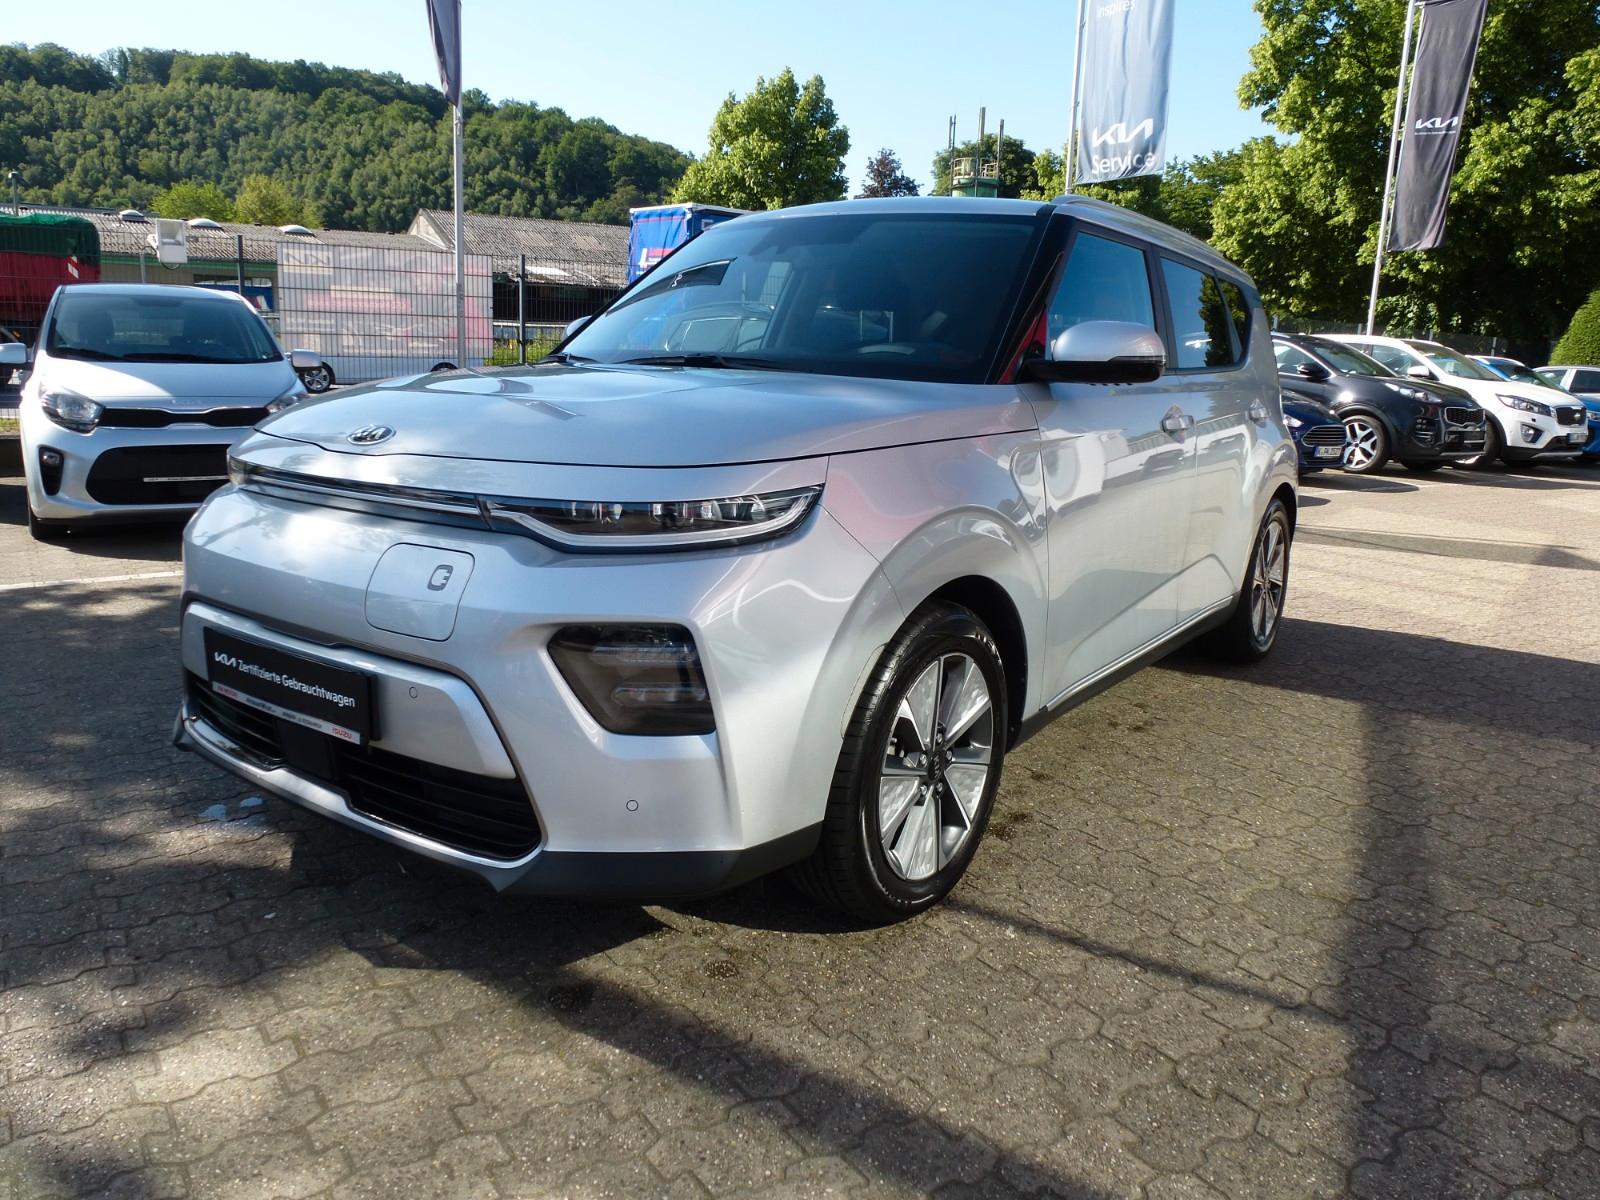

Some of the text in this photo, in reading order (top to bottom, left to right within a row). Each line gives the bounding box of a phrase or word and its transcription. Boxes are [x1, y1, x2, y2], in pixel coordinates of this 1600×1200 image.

[1092, 118, 1154, 147] KIA
[1415, 116, 1459, 129] KIA
[1091, 150, 1157, 175] Service
[214, 651, 237, 668] KIA
[238, 659, 281, 684] Zertifizierte
[282, 674, 356, 708] Gebrauchtwagen
